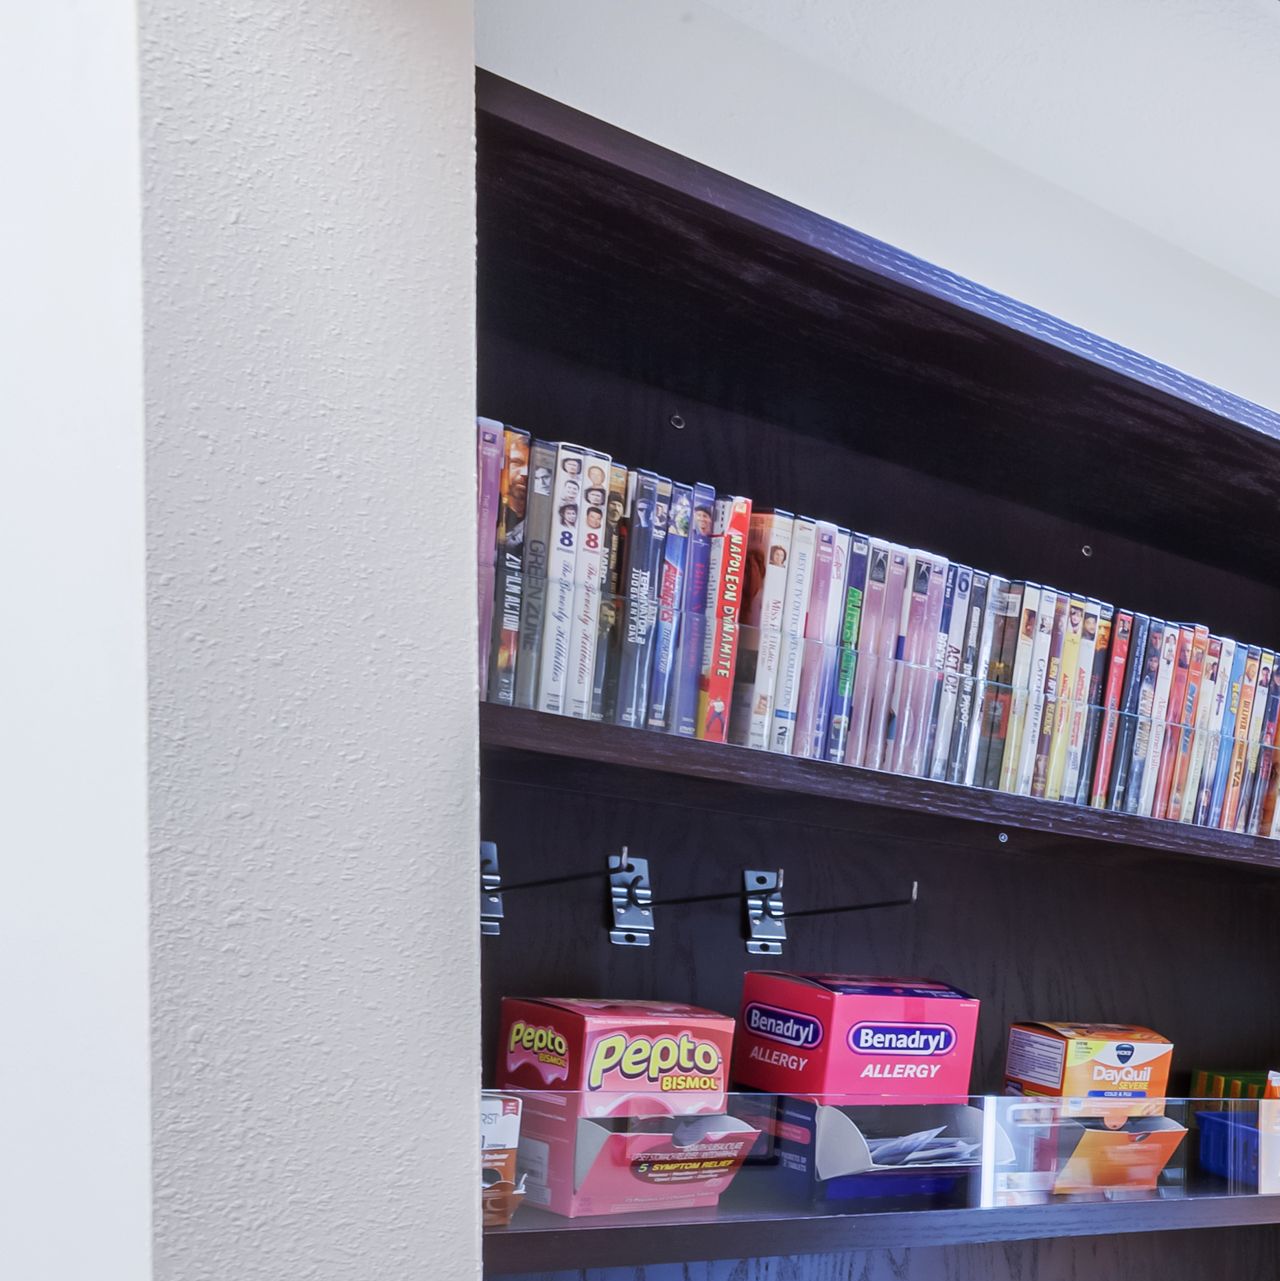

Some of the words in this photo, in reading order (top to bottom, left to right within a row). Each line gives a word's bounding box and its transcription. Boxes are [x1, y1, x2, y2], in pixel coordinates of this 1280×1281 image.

[560, 531, 574, 547] 8
[585, 533, 599, 549] 8
[528, 539, 546, 599] GREEN
[723, 534, 743, 602] NAPOLEON
[958, 572, 970, 593] 6
[716, 605, 736, 678] DYNAMITE
[509, 1020, 568, 1053] Pepto
[749, 1007, 815, 1048] Benadryl
[858, 1027, 945, 1056] Benadryl
[538, 1053, 568, 1067] BISMOL
[588, 1031, 720, 1091] Pepto
[749, 1046, 809, 1072] ALLERGY
[661, 1072, 719, 1092] BISMOL
[860, 1063, 941, 1079] ALLERGY
[1093, 1066, 1152, 1085] DayQuil
[638, 1164, 648, 1173] 5
[652, 1161, 700, 1172] SYMPTOM
[701, 1159, 734, 1169] RELIEF
